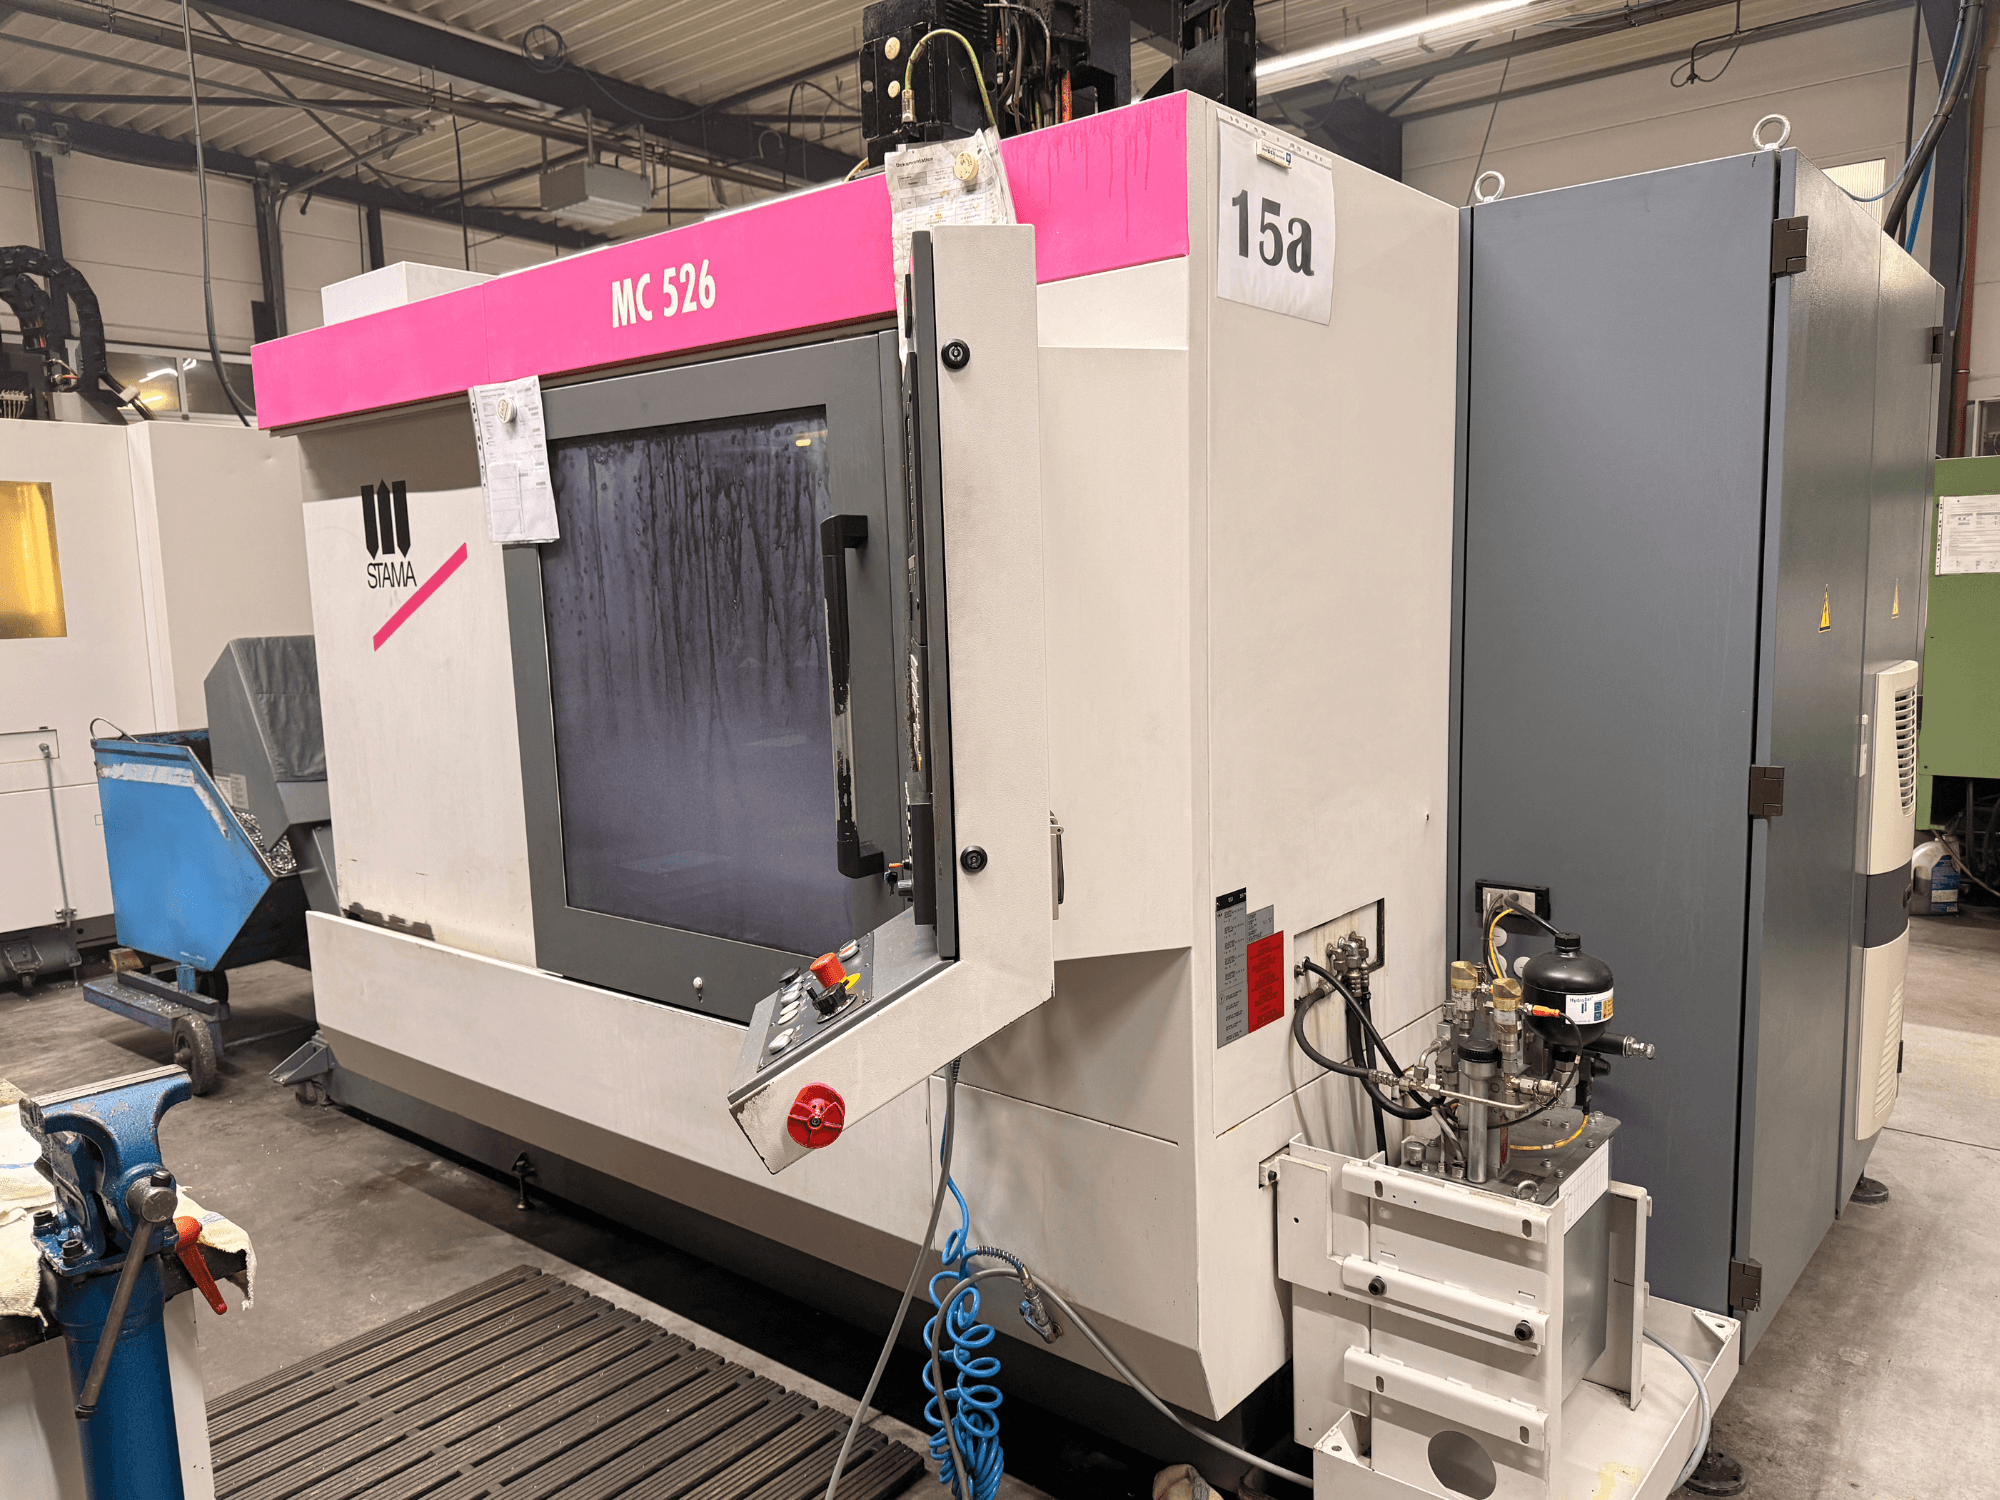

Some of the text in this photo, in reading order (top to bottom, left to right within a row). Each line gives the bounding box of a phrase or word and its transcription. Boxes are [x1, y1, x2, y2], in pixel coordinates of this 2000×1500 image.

[1231, 189, 1315, 277] 15a
[611, 259, 716, 329] MC 526
[366, 560, 418, 590] STAMA
